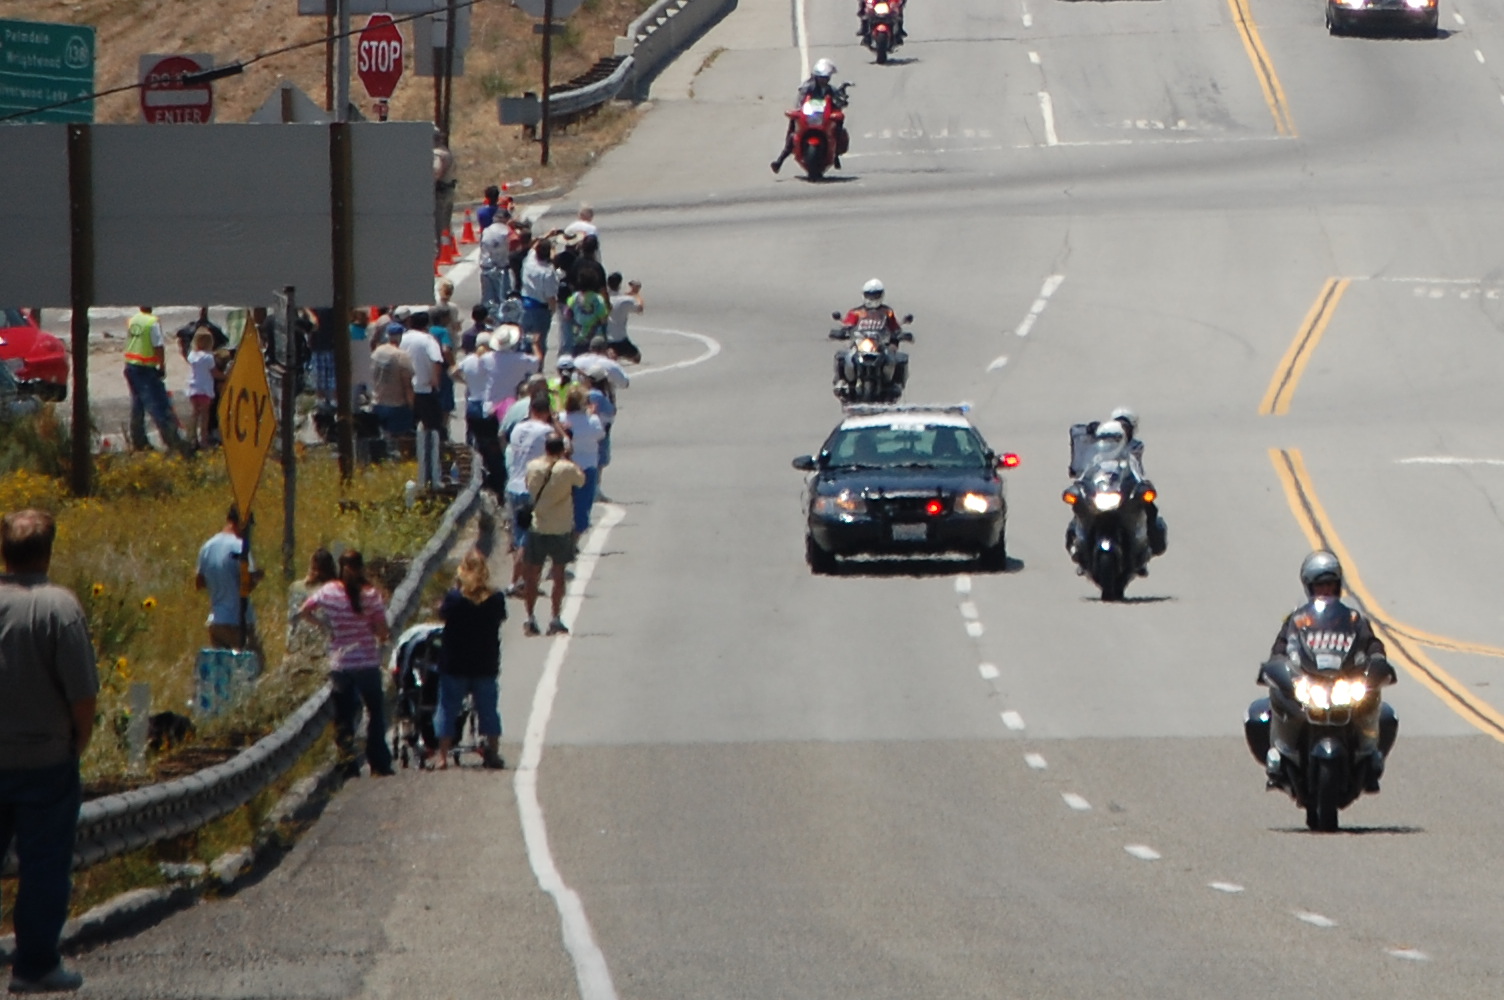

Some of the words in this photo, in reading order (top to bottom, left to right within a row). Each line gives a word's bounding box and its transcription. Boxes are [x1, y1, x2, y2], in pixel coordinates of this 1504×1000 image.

[5, 28, 50, 45] Palmdale
[6, 50, 61, 70] Wrightwood
[69, 44, 88, 62] 138
[360, 41, 401, 72] STOP
[151, 72, 170, 88] DO
[155, 108, 201, 124] ENTER
[226, 385, 267, 447] ICY
